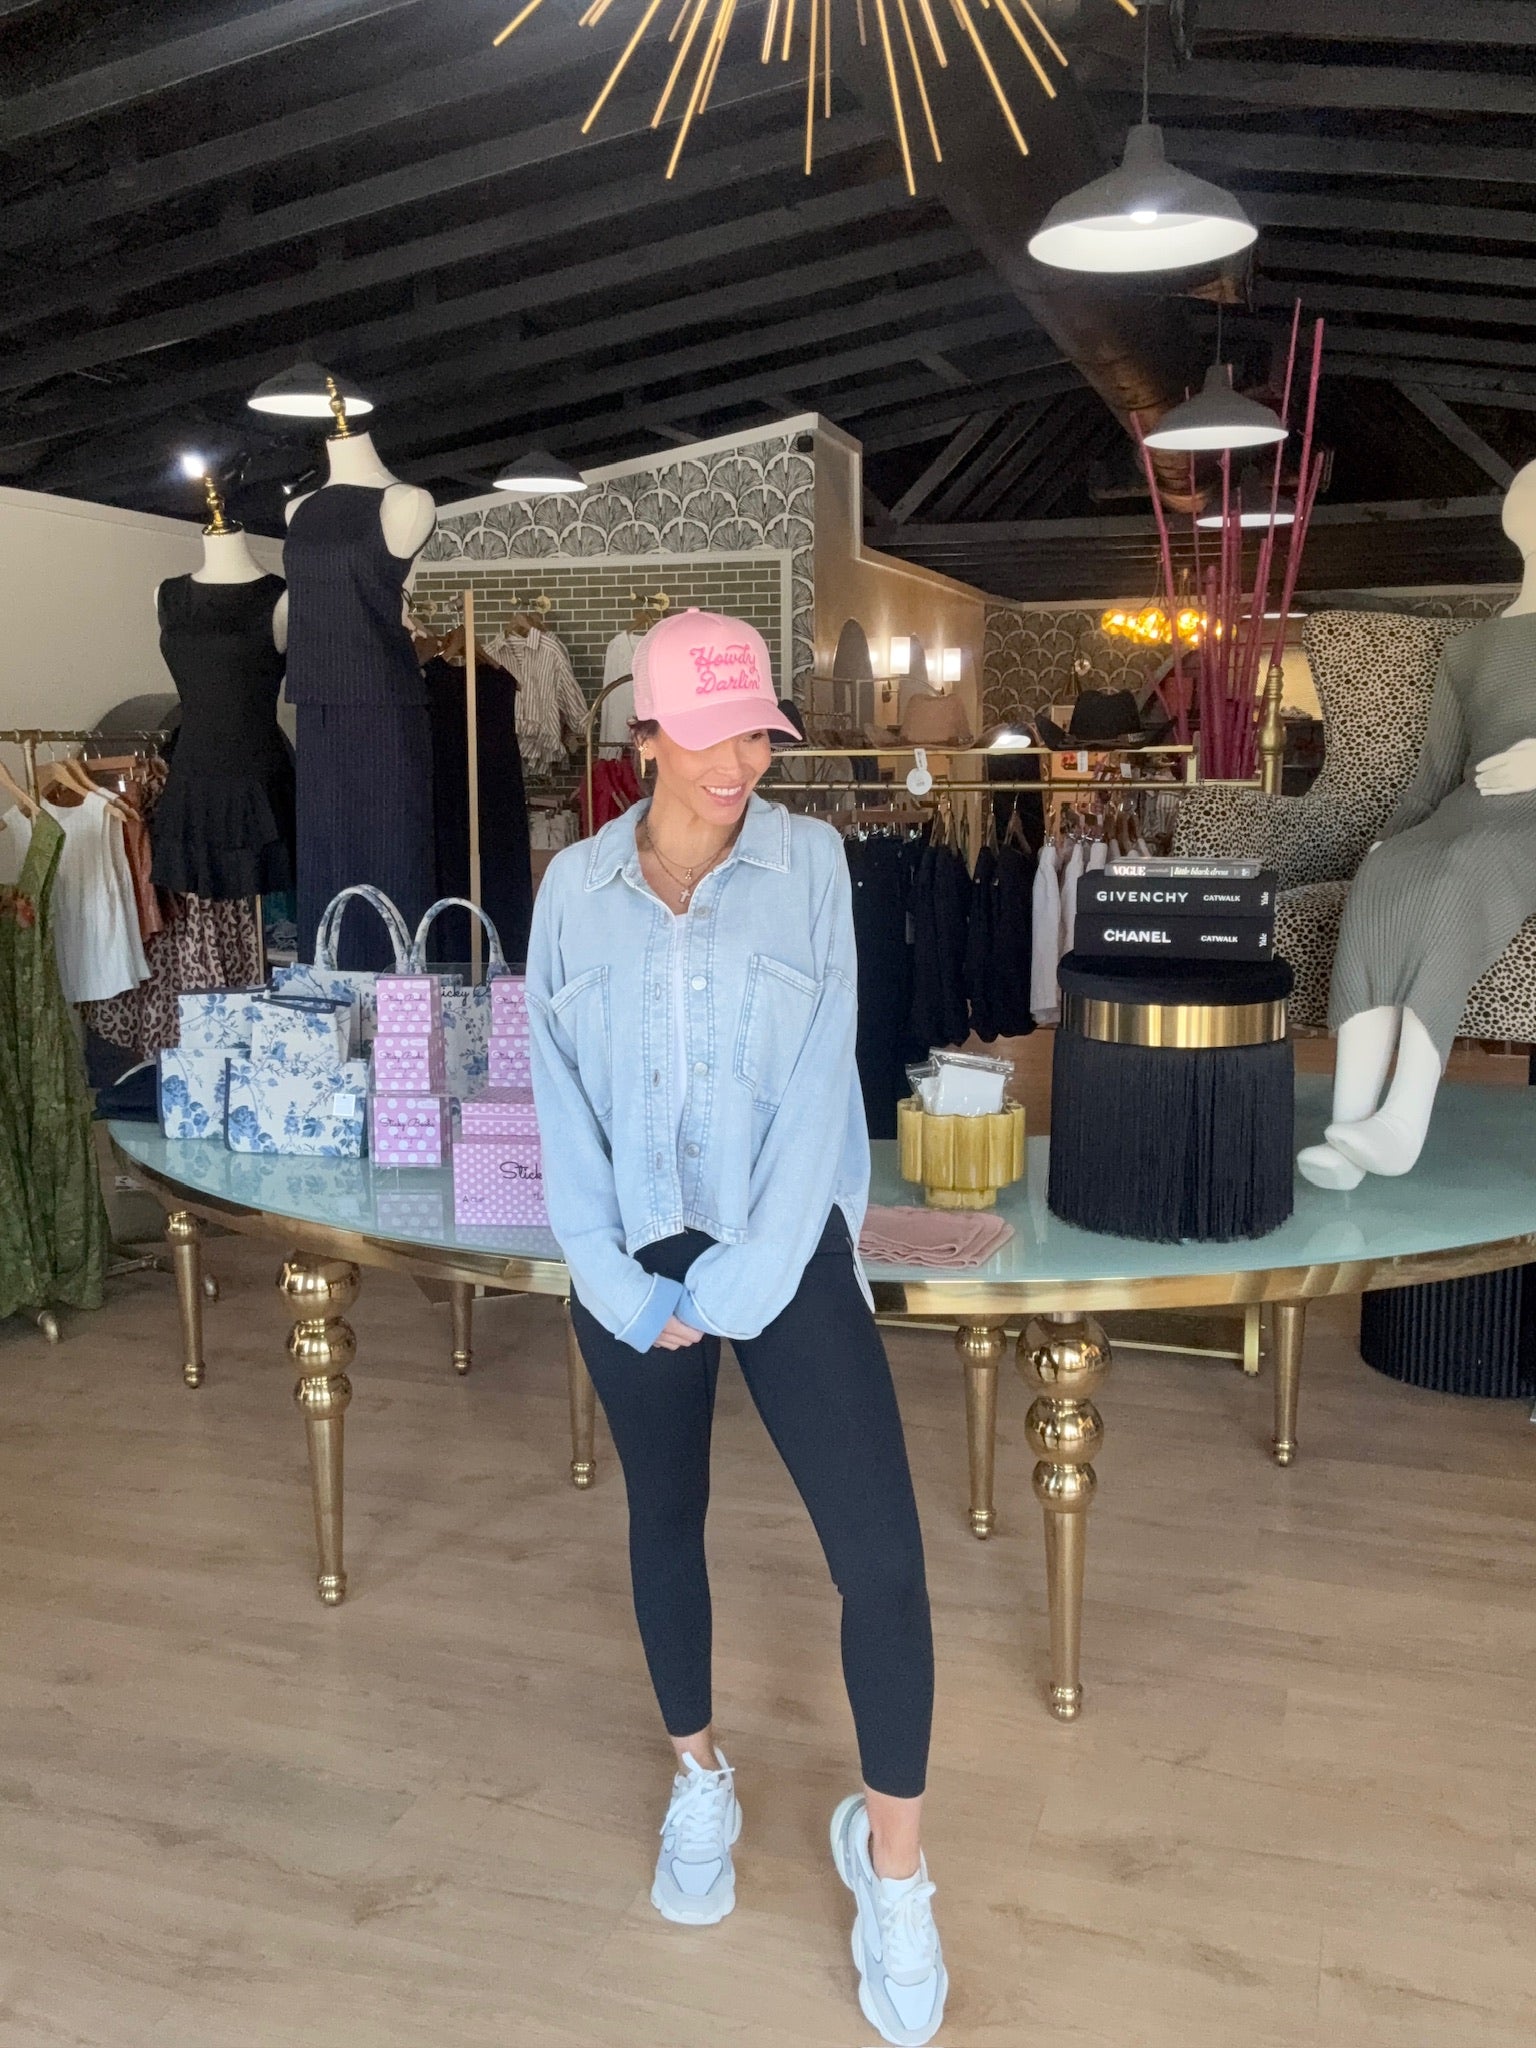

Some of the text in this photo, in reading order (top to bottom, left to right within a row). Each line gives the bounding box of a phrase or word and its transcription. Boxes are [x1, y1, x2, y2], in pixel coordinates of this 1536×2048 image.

[689, 644, 758, 673] Howdy
[696, 670, 760, 694] Darlin'
[1112, 866, 1146, 877] VOGUE
[1174, 866, 1190, 876] little
[1190, 867, 1209, 876] black
[1096, 891, 1241, 903] GIVENCHY CATWALK
[1103, 929, 1238, 944] CHANEL CATWALK
[441, 983, 470, 1007] icky
[499, 1160, 543, 1181] Stick
